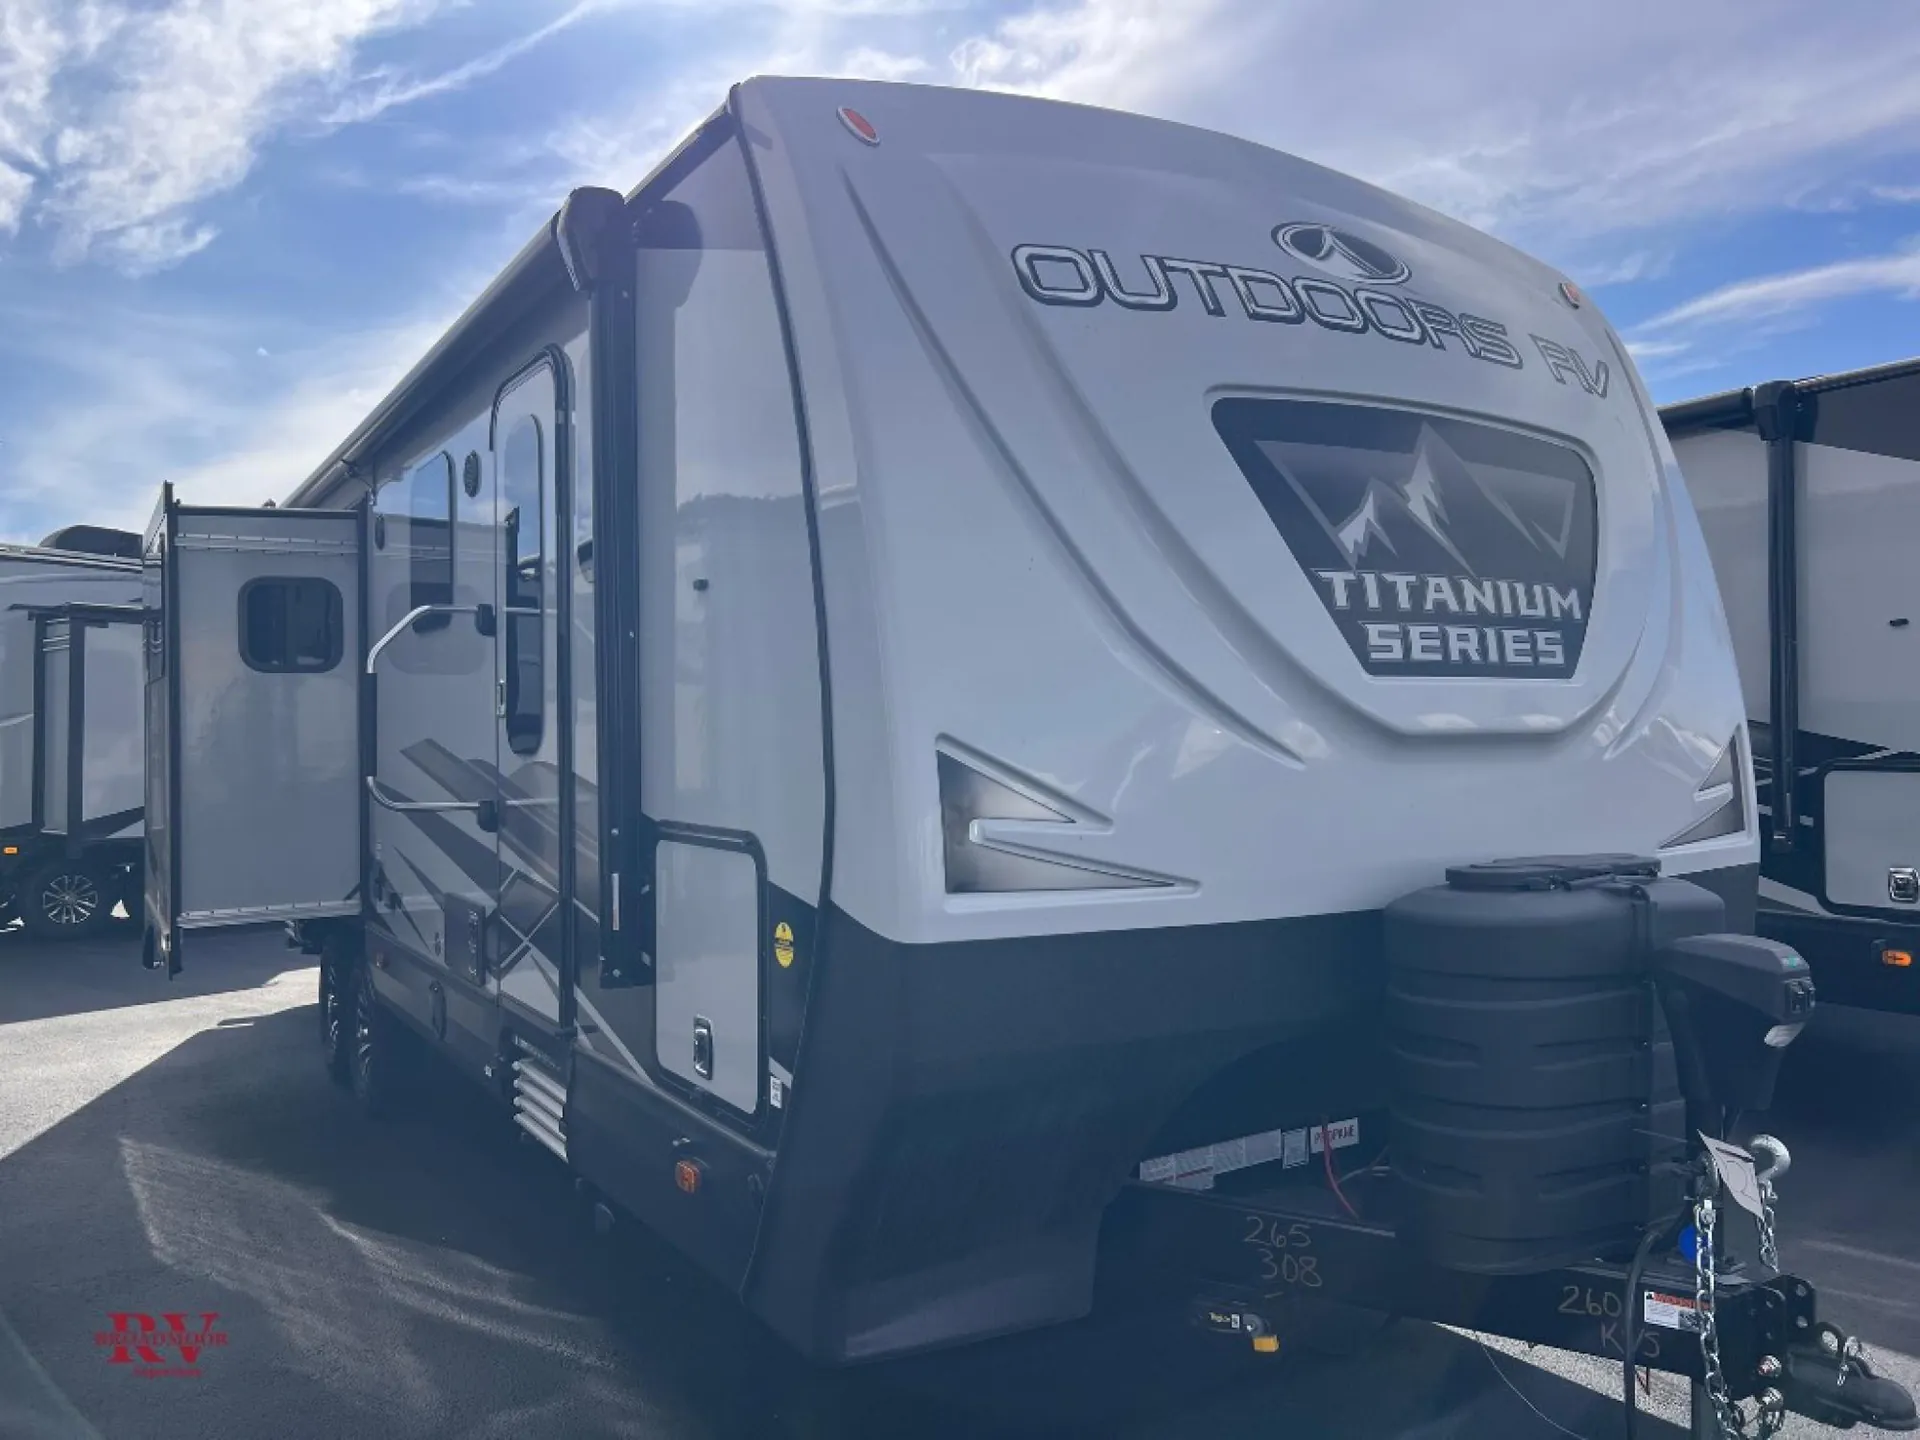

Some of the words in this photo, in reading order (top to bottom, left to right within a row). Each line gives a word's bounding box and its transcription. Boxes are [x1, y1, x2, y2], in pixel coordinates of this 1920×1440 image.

[1011, 244, 1523, 370] OUTDOORS
[1529, 333, 1610, 399] RV
[1312, 568, 1582, 620] TITANIUM
[1360, 621, 1565, 665] SERIES
[1243, 1216, 1312, 1248] 265
[1257, 1249, 1322, 1287] 308
[1557, 1285, 1623, 1318] 260
